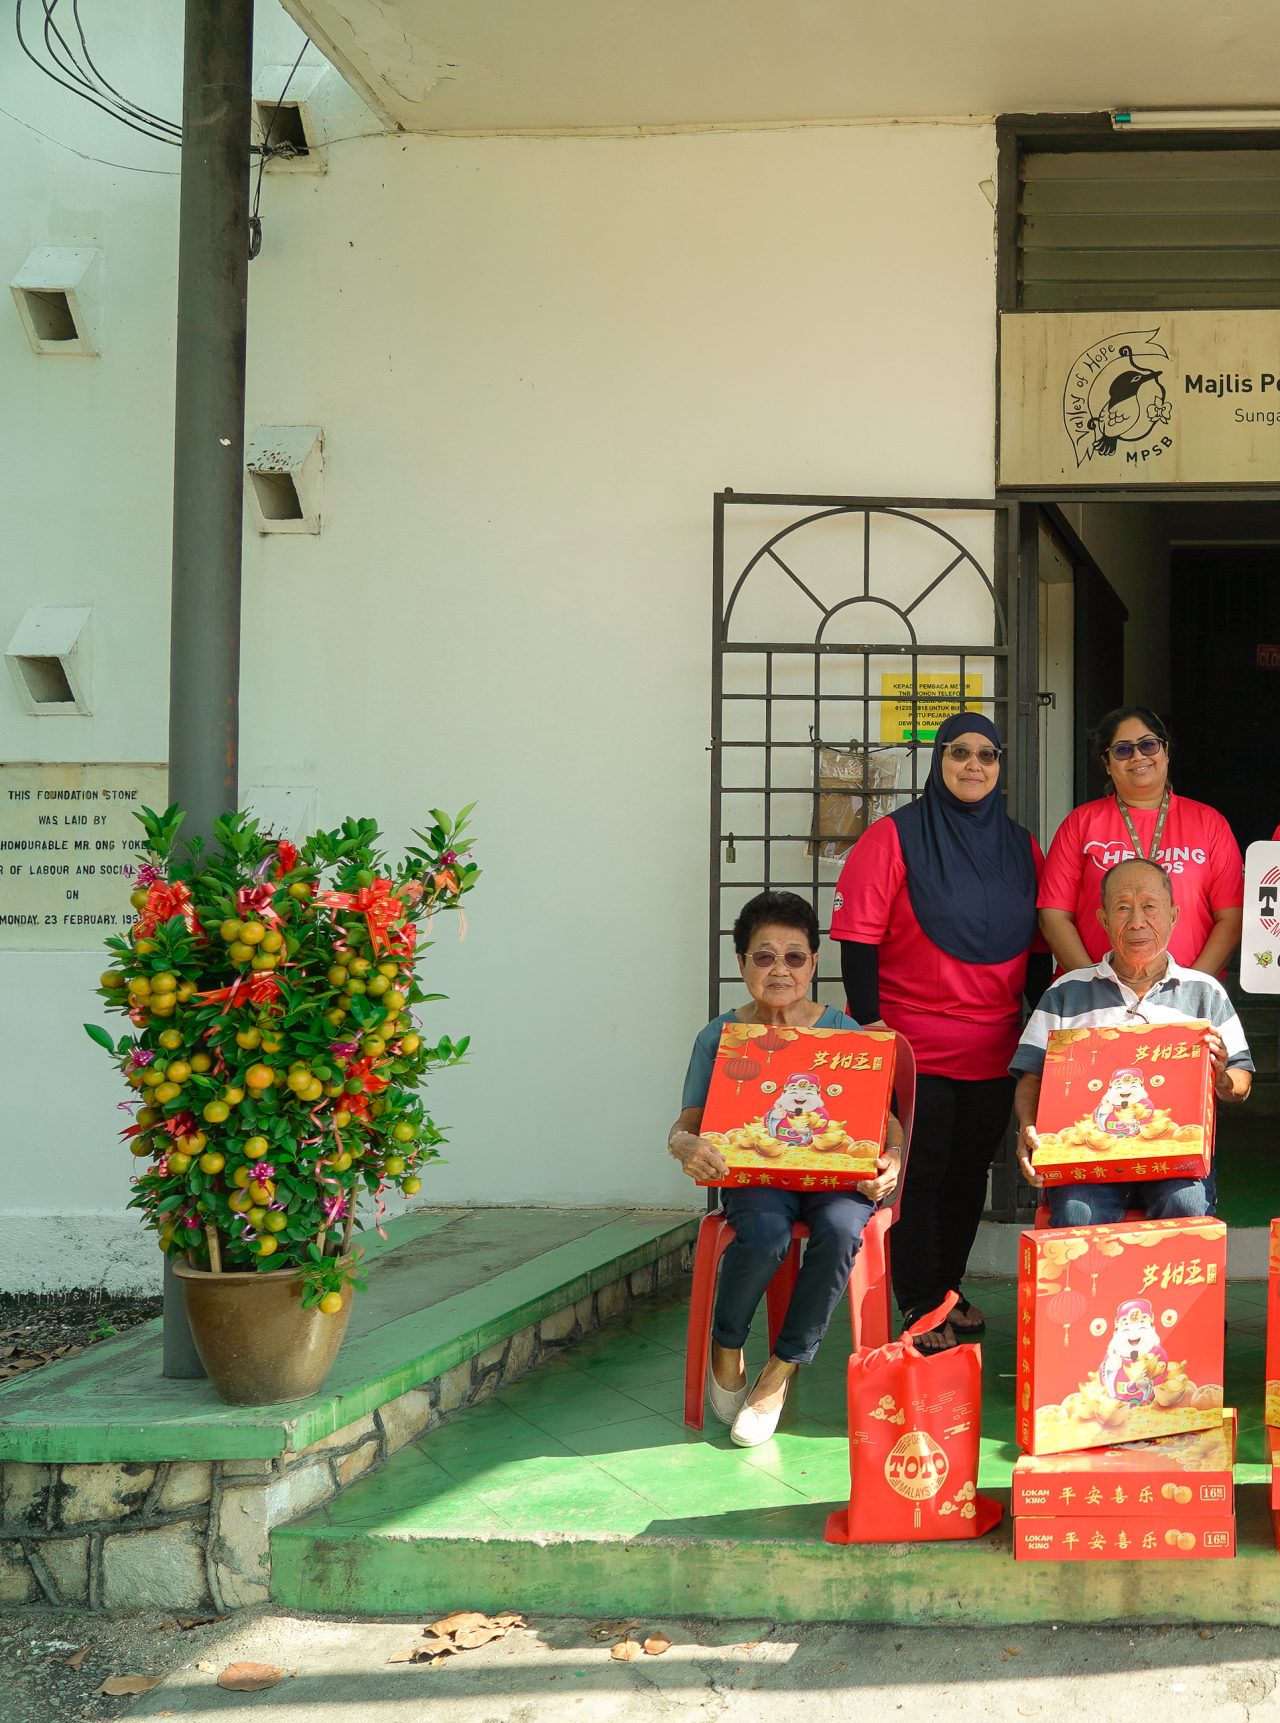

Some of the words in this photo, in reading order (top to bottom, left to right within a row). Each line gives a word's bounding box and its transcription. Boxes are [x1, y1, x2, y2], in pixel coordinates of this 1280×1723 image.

[1083, 344, 1116, 373] Hope
[1075, 373, 1089, 388] of
[1185, 374, 1253, 398] Majlis
[1066, 393, 1090, 447] Valley
[1126, 436, 1173, 463] MPSB
[8, 790, 31, 800] THIS
[37, 790, 99, 800] FOUNDATION
[105, 790, 138, 800] STONE
[38, 815, 58, 825] WAS
[64, 815, 88, 825] LAID
[93, 815, 107, 825] BY
[0, 840, 68, 850] HONOURABLE
[74, 840, 91, 850] MR.
[95, 840, 115, 850] ONG
[122, 840, 147, 850] YOKE
[10, 865, 23, 875] OF
[29, 865, 69, 875] LABOUR
[76, 865, 96, 875] AND
[100, 865, 135, 875] SOCIAL
[66, 890, 79, 899] ON
[44, 914, 58, 925] 23
[122, 914, 141, 925] 195
[1070, 1166, 1108, 1180] 富贵
[1131, 1162, 1171, 1175] 吉祥
[734, 1172, 774, 1184] 富贵
[800, 1175, 840, 1188] 吉祥
[889, 1452, 947, 1479] TOTO
[1021, 1489, 1050, 1497] LOKAM
[1058, 1485, 1154, 1506] 平安喜乐
[1062, 1530, 1158, 1551] 平安喜乐
